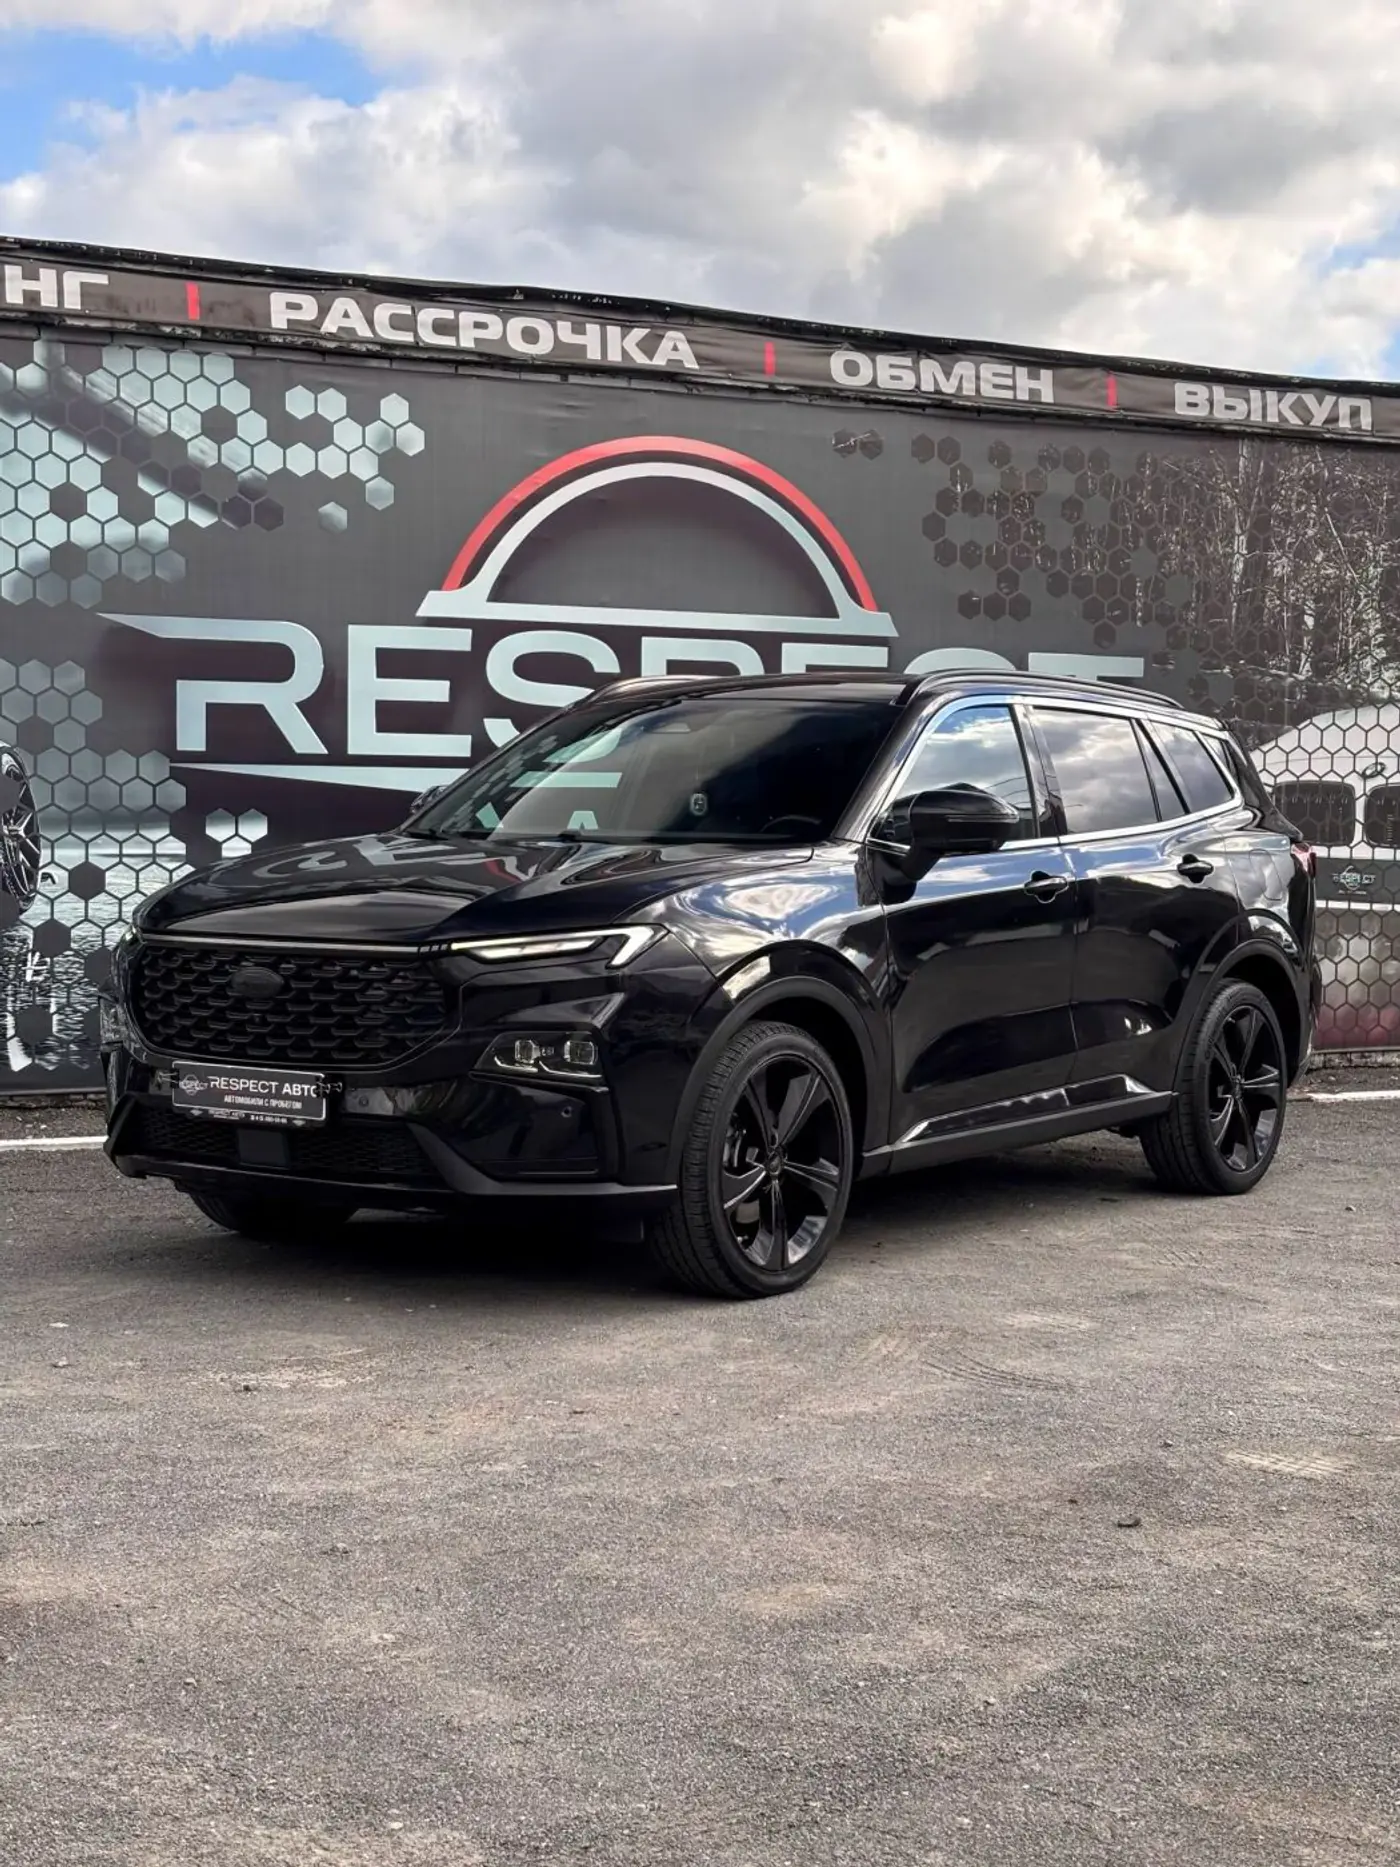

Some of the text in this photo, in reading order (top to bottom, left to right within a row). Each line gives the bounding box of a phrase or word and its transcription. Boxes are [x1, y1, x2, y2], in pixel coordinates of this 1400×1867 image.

[4, 264, 1372, 431] НГ РАССРОЧКА ОБМЕН ВЫКУП
[206, 1075, 279, 1094] RESPECT
